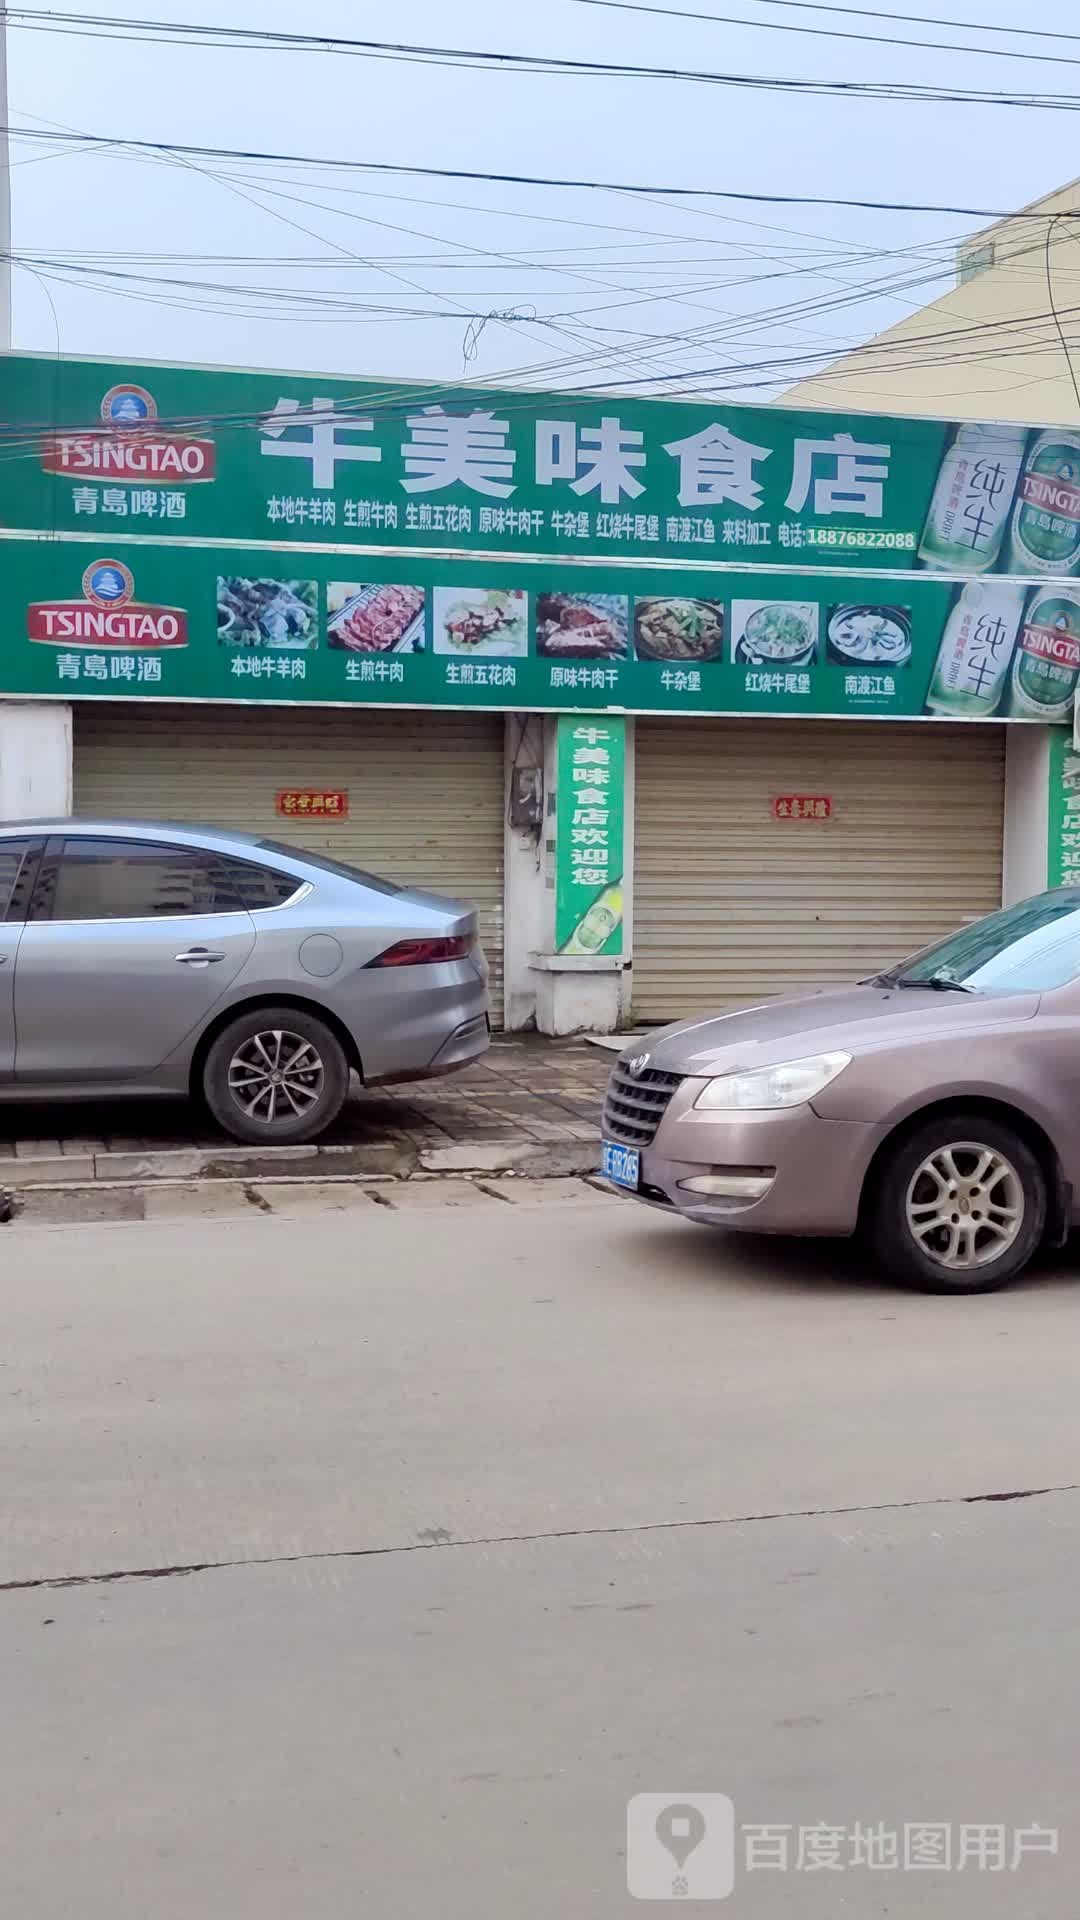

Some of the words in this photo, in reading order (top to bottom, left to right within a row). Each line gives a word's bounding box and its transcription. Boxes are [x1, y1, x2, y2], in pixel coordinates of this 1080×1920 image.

[56, 440, 204, 473] TSINGTAO
[260, 397, 891, 517] 牛美味食店
[267, 494, 336, 526] 本地牛羊肉
[344, 499, 397, 529] 生煎牛肉
[405, 502, 472, 533] 生煎五花肉
[479, 506, 544, 536] 原味牛肉干
[551, 510, 590, 538] 牛杂堡
[596, 512, 660, 541] 红烧牛尾堡
[666, 516, 716, 543] 南渡江鱼
[722, 518, 771, 545] 来料加工
[39, 611, 179, 640] TSINGTAO
[231, 655, 306, 679] 本地牛羊肉
[345, 659, 404, 682] 生煎牛肉
[445, 663, 516, 686] 生煎五花肉
[550, 667, 618, 689] 原味牛肉干
[660, 670, 701, 691] 牛杂堡
[745, 672, 811, 694] 红烧牛尾堡
[845, 675, 896, 695] 南渡江鱼
[571, 728, 610, 886] 牛美味食店欢迎您
